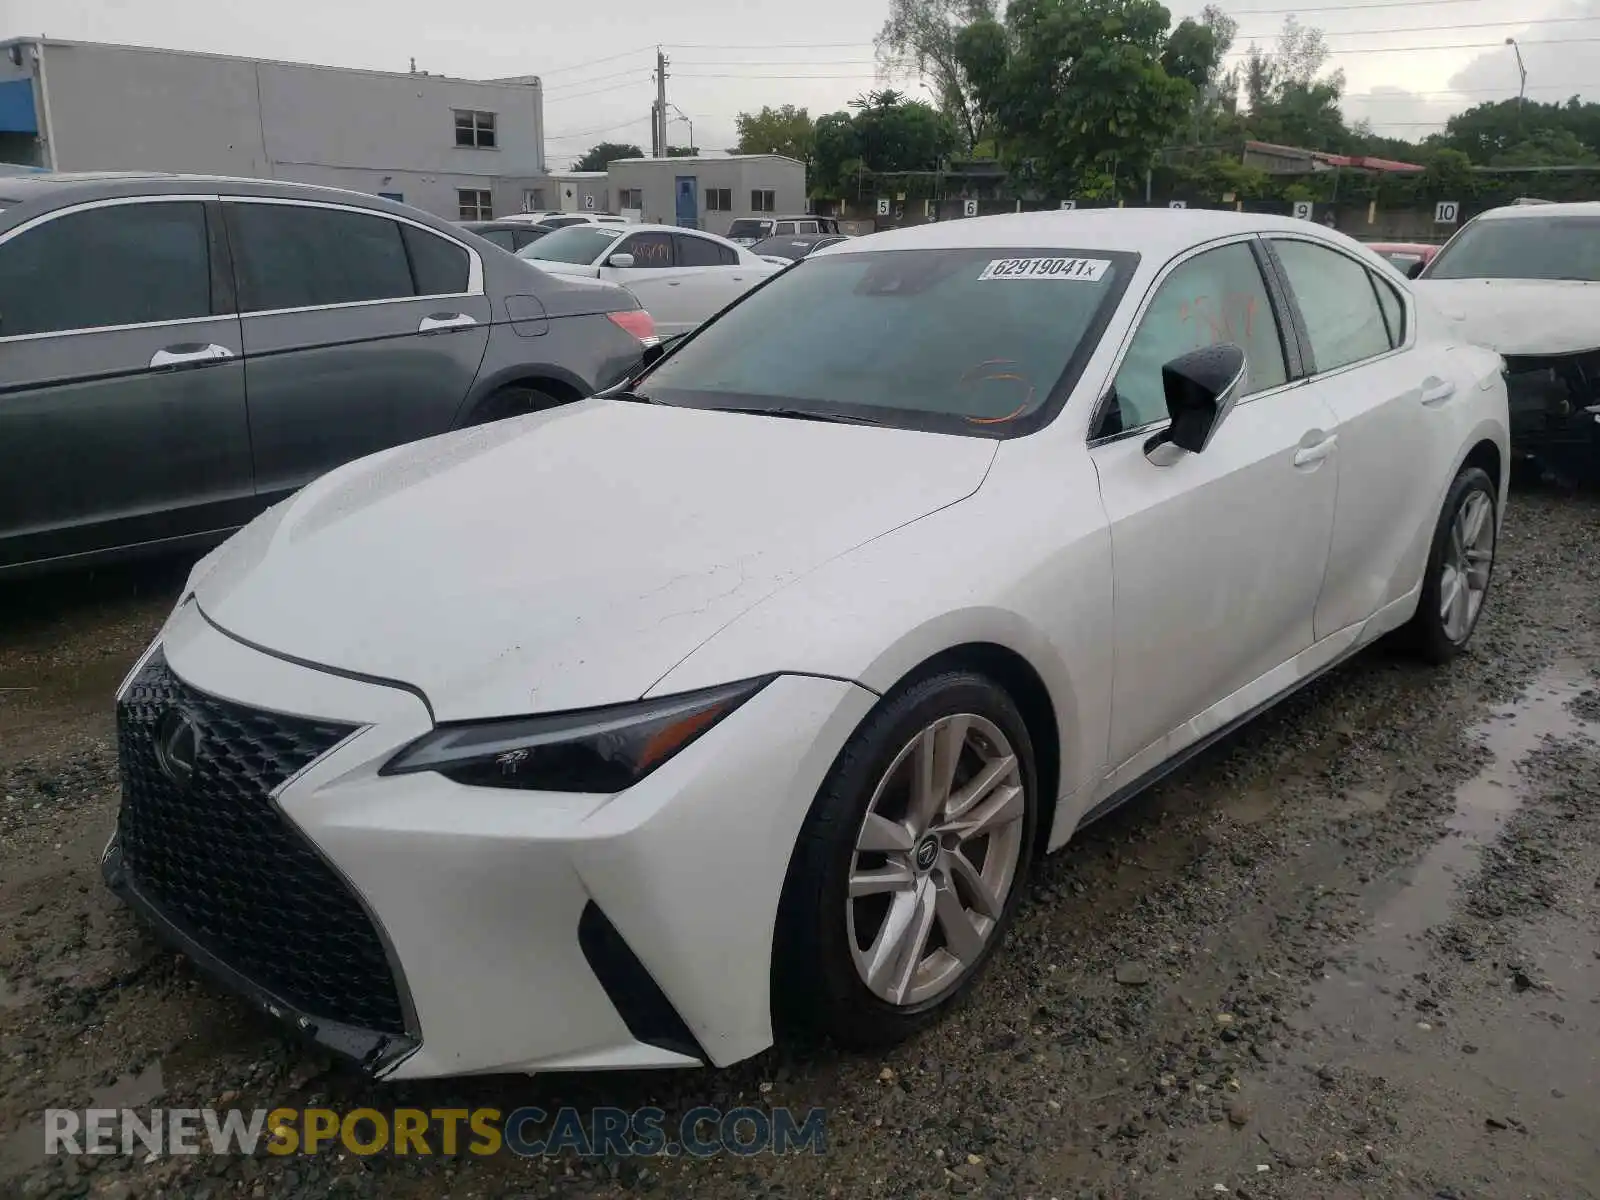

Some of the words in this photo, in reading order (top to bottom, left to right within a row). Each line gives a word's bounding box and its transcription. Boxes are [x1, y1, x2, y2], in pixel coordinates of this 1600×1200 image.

[586, 196, 593, 208] 2
[880, 201, 887, 213] 5
[967, 202, 975, 215] 6
[1297, 204, 1308, 219] 9
[1437, 204, 1456, 221] 10
